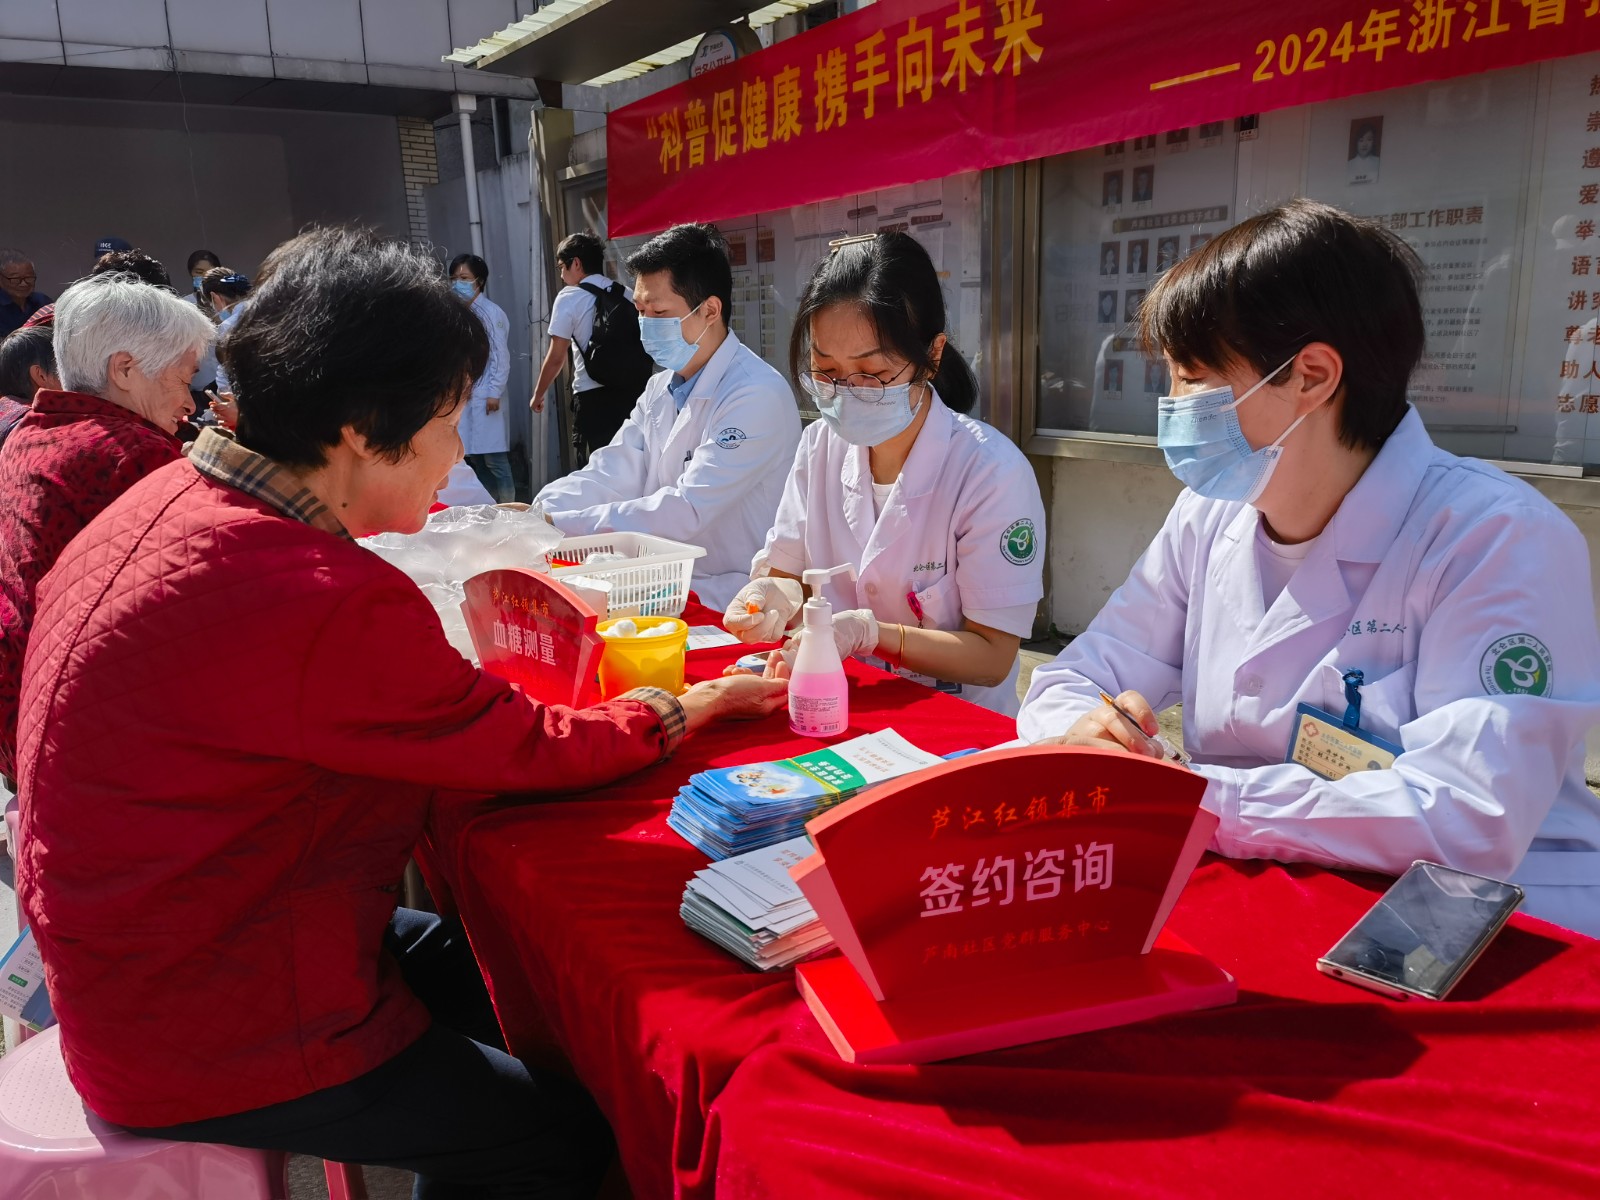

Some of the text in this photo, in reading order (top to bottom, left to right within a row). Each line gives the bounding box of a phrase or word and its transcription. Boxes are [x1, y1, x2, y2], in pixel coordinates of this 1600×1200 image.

[815, 0, 1044, 132] 携手向未来
[1578, 183, 1600, 205] 爱
[1574, 218, 1600, 240] 举
[1571, 255, 1600, 276] 语
[1560, 360, 1600, 380] 助人
[1556, 393, 1600, 414] 志愿
[1340, 619, 1408, 640] 区第二人
[493, 619, 557, 667] 血糖测量
[929, 785, 1110, 840] 芦江红领集市
[919, 841, 1114, 918] 签约咨询
